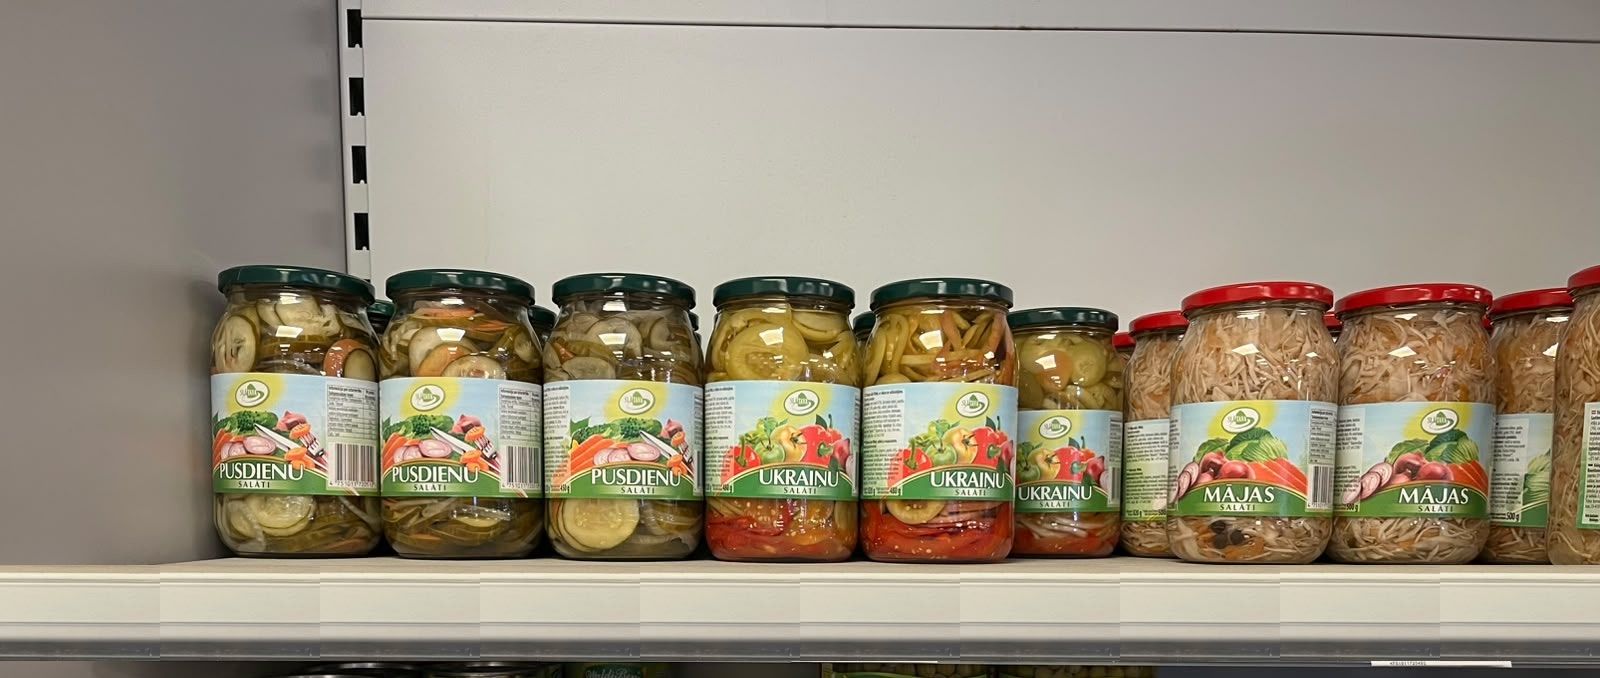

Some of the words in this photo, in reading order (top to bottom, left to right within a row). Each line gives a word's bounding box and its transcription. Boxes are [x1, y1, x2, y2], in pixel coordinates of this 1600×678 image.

[219, 462, 304, 481] PUSDIENU
[392, 465, 479, 484] PUSDIENU
[591, 468, 681, 487] PUSDIENU
[1203, 483, 1275, 503] MĀJAS
[1398, 485, 1469, 505] MĀJAS
